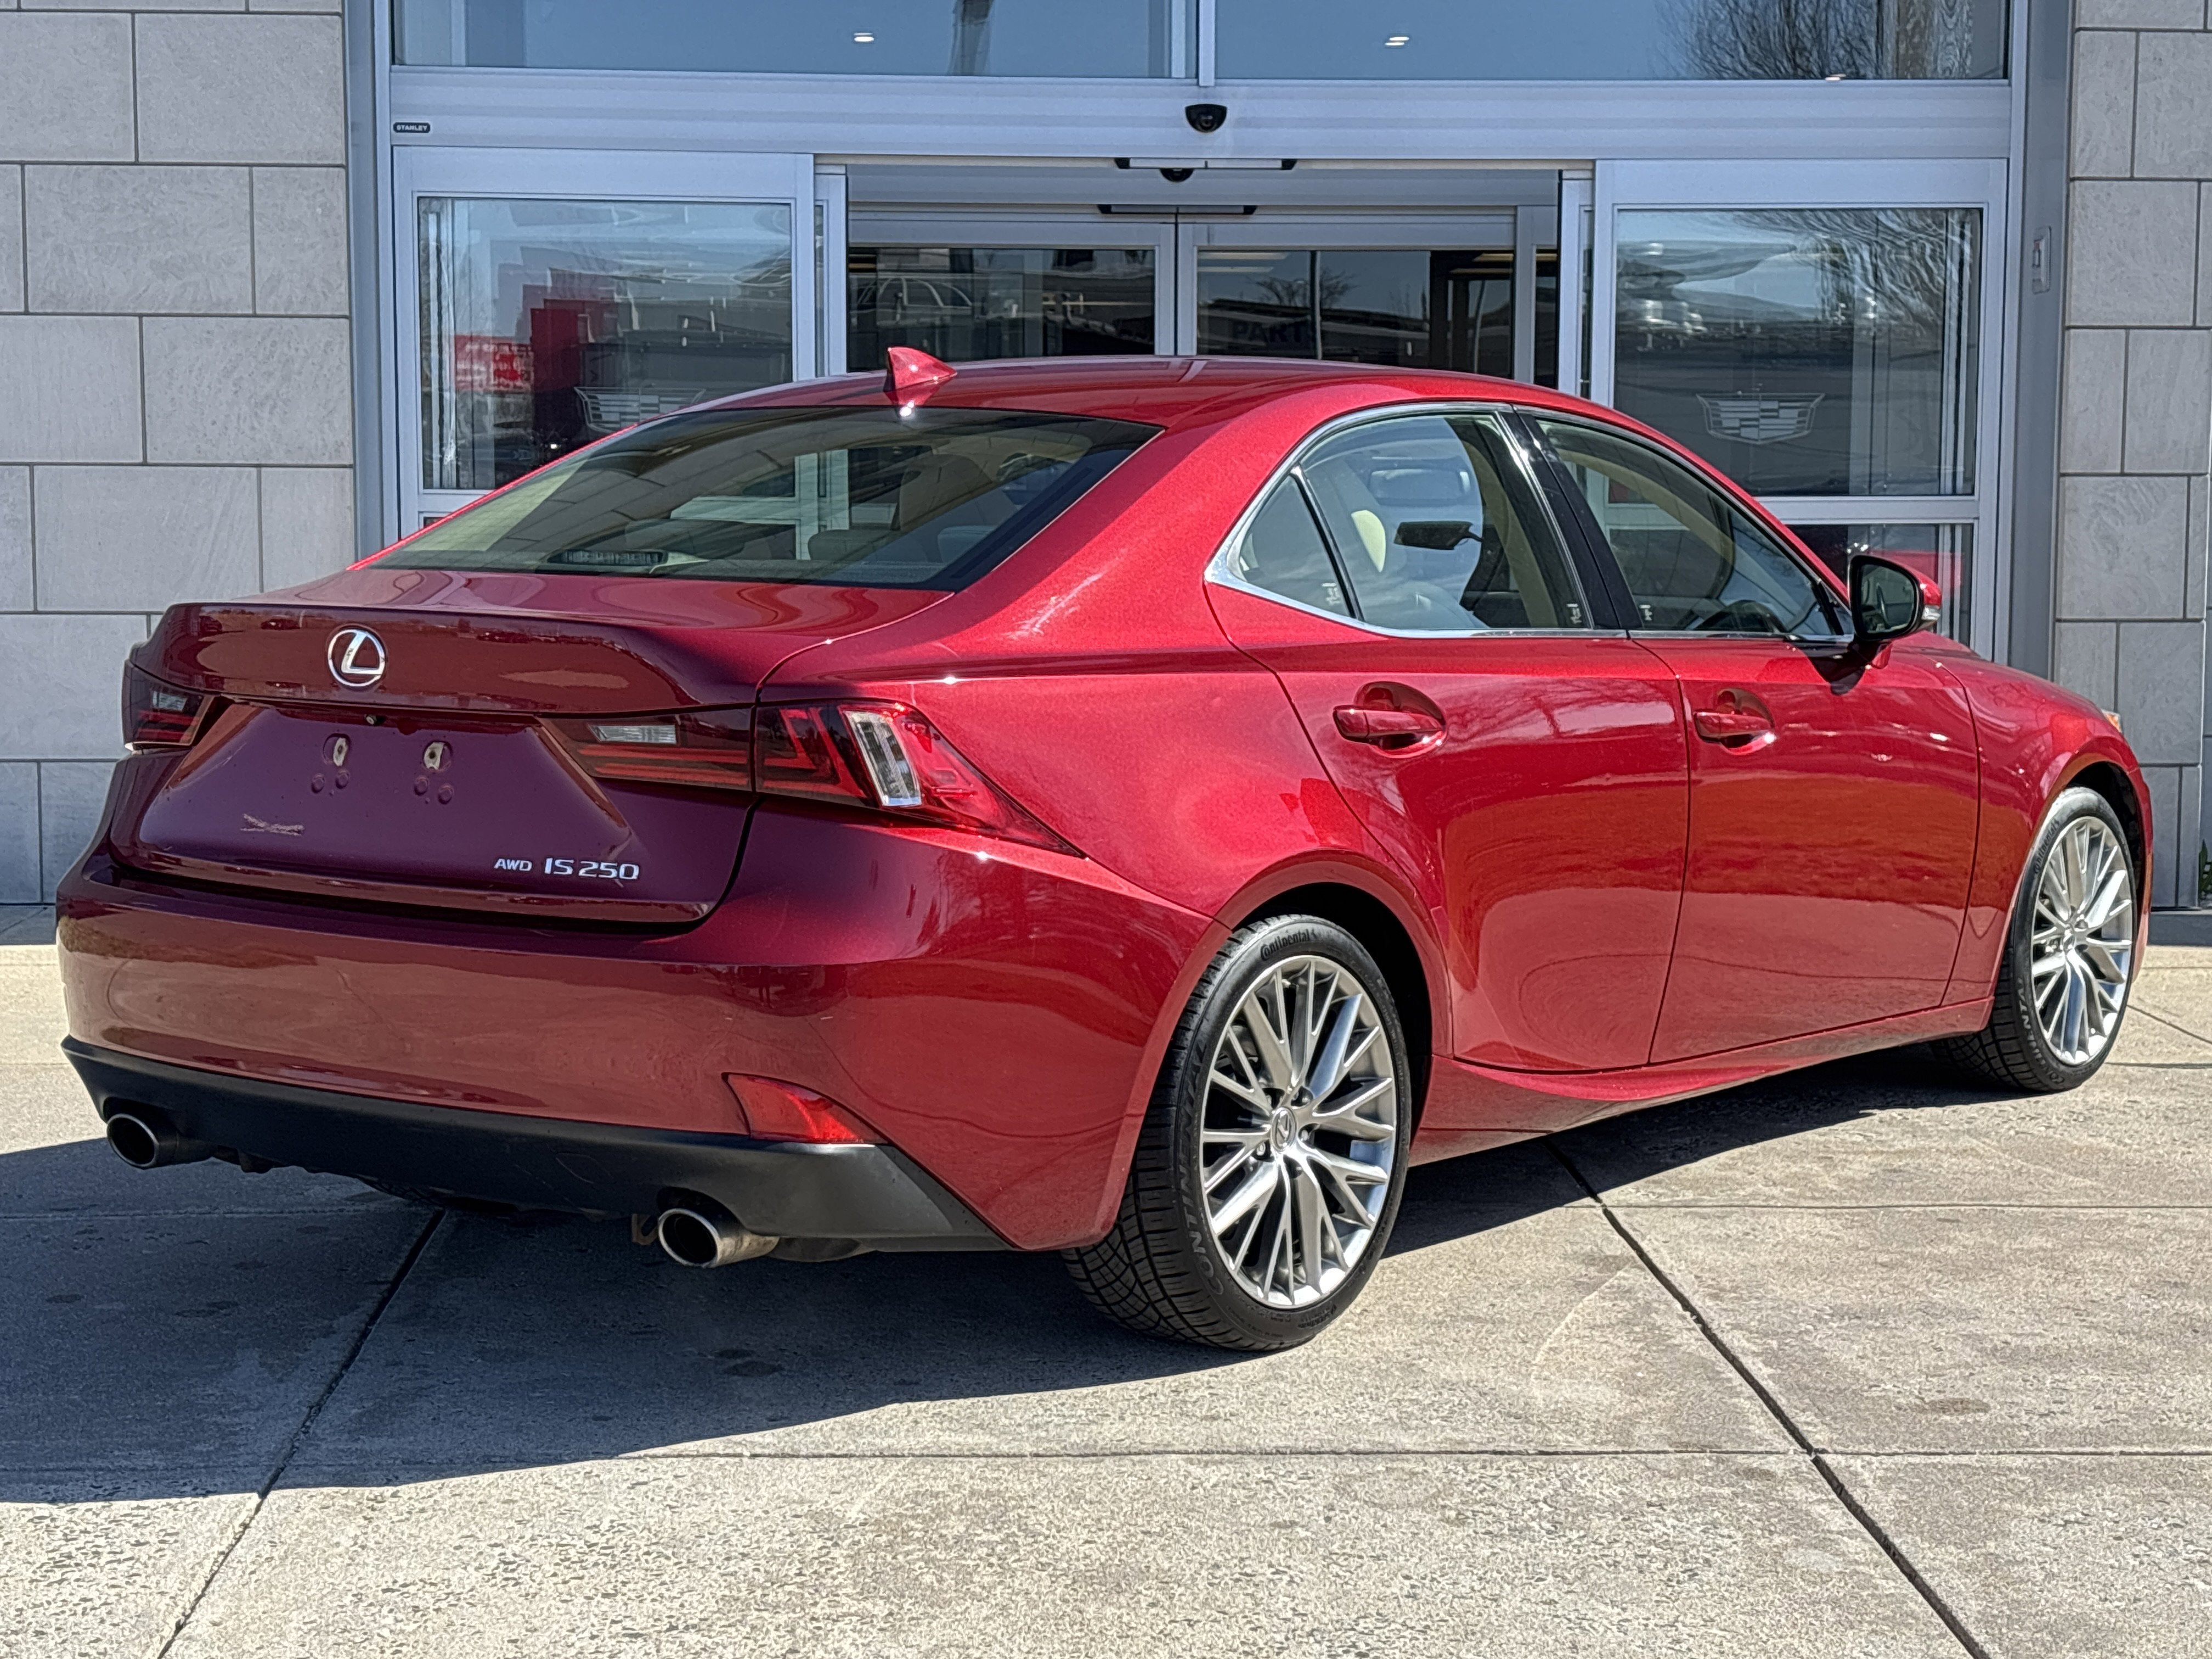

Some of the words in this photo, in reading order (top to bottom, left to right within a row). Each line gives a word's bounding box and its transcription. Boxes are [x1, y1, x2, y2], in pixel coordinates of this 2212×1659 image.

[1234, 320, 1315, 343] PART
[494, 858, 533, 872] AWD
[545, 857, 574, 875] IS
[578, 861, 640, 880] 250
[1260, 928, 1310, 961] Continental
